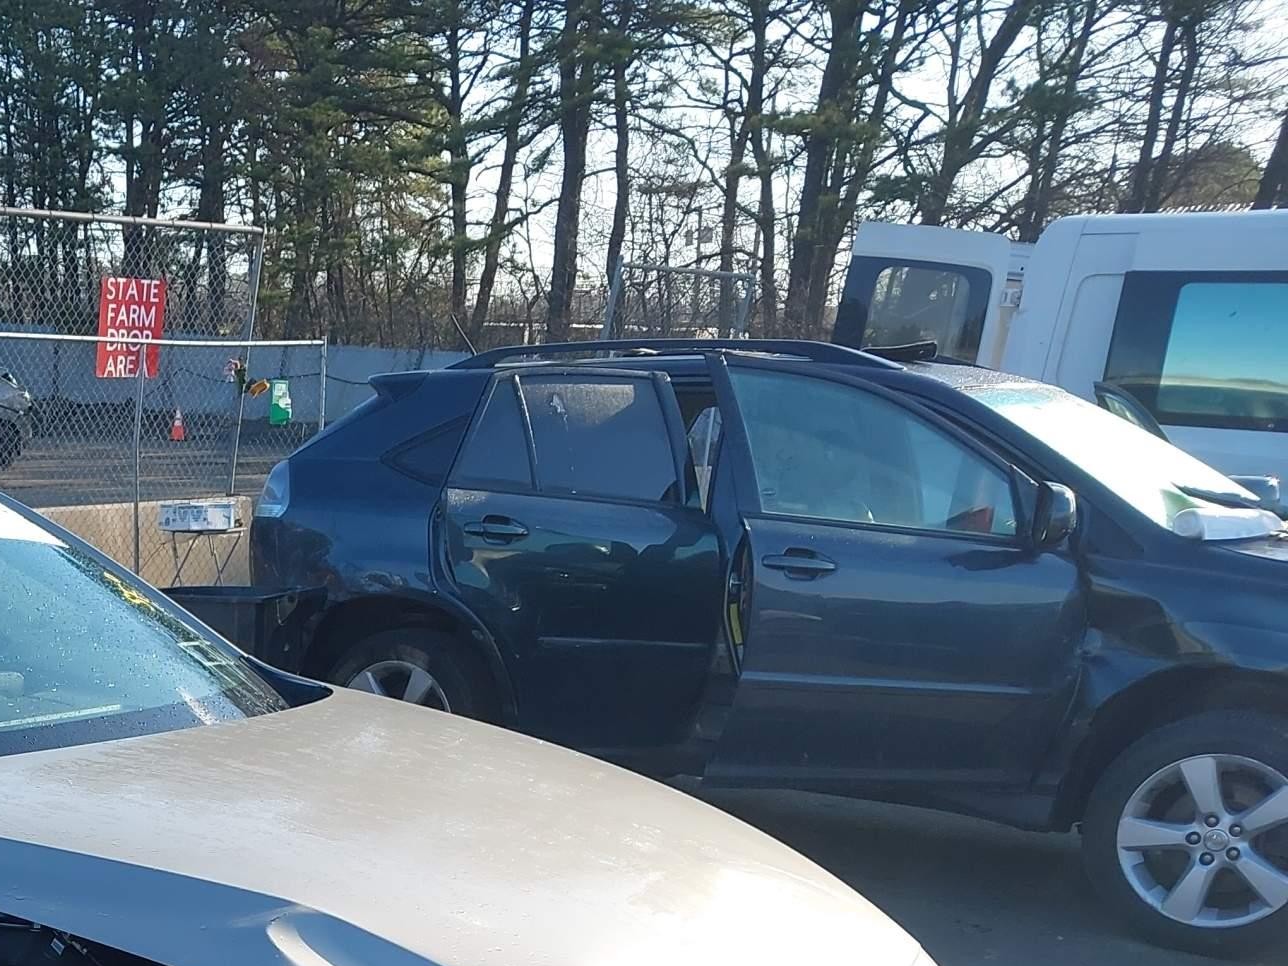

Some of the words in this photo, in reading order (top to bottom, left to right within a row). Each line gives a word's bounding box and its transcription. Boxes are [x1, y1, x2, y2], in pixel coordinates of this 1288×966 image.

[106, 277, 160, 302] STATE
[107, 303, 156, 328] FARM
[106, 328, 153, 352] DROP
[103, 354, 150, 378] AREA
